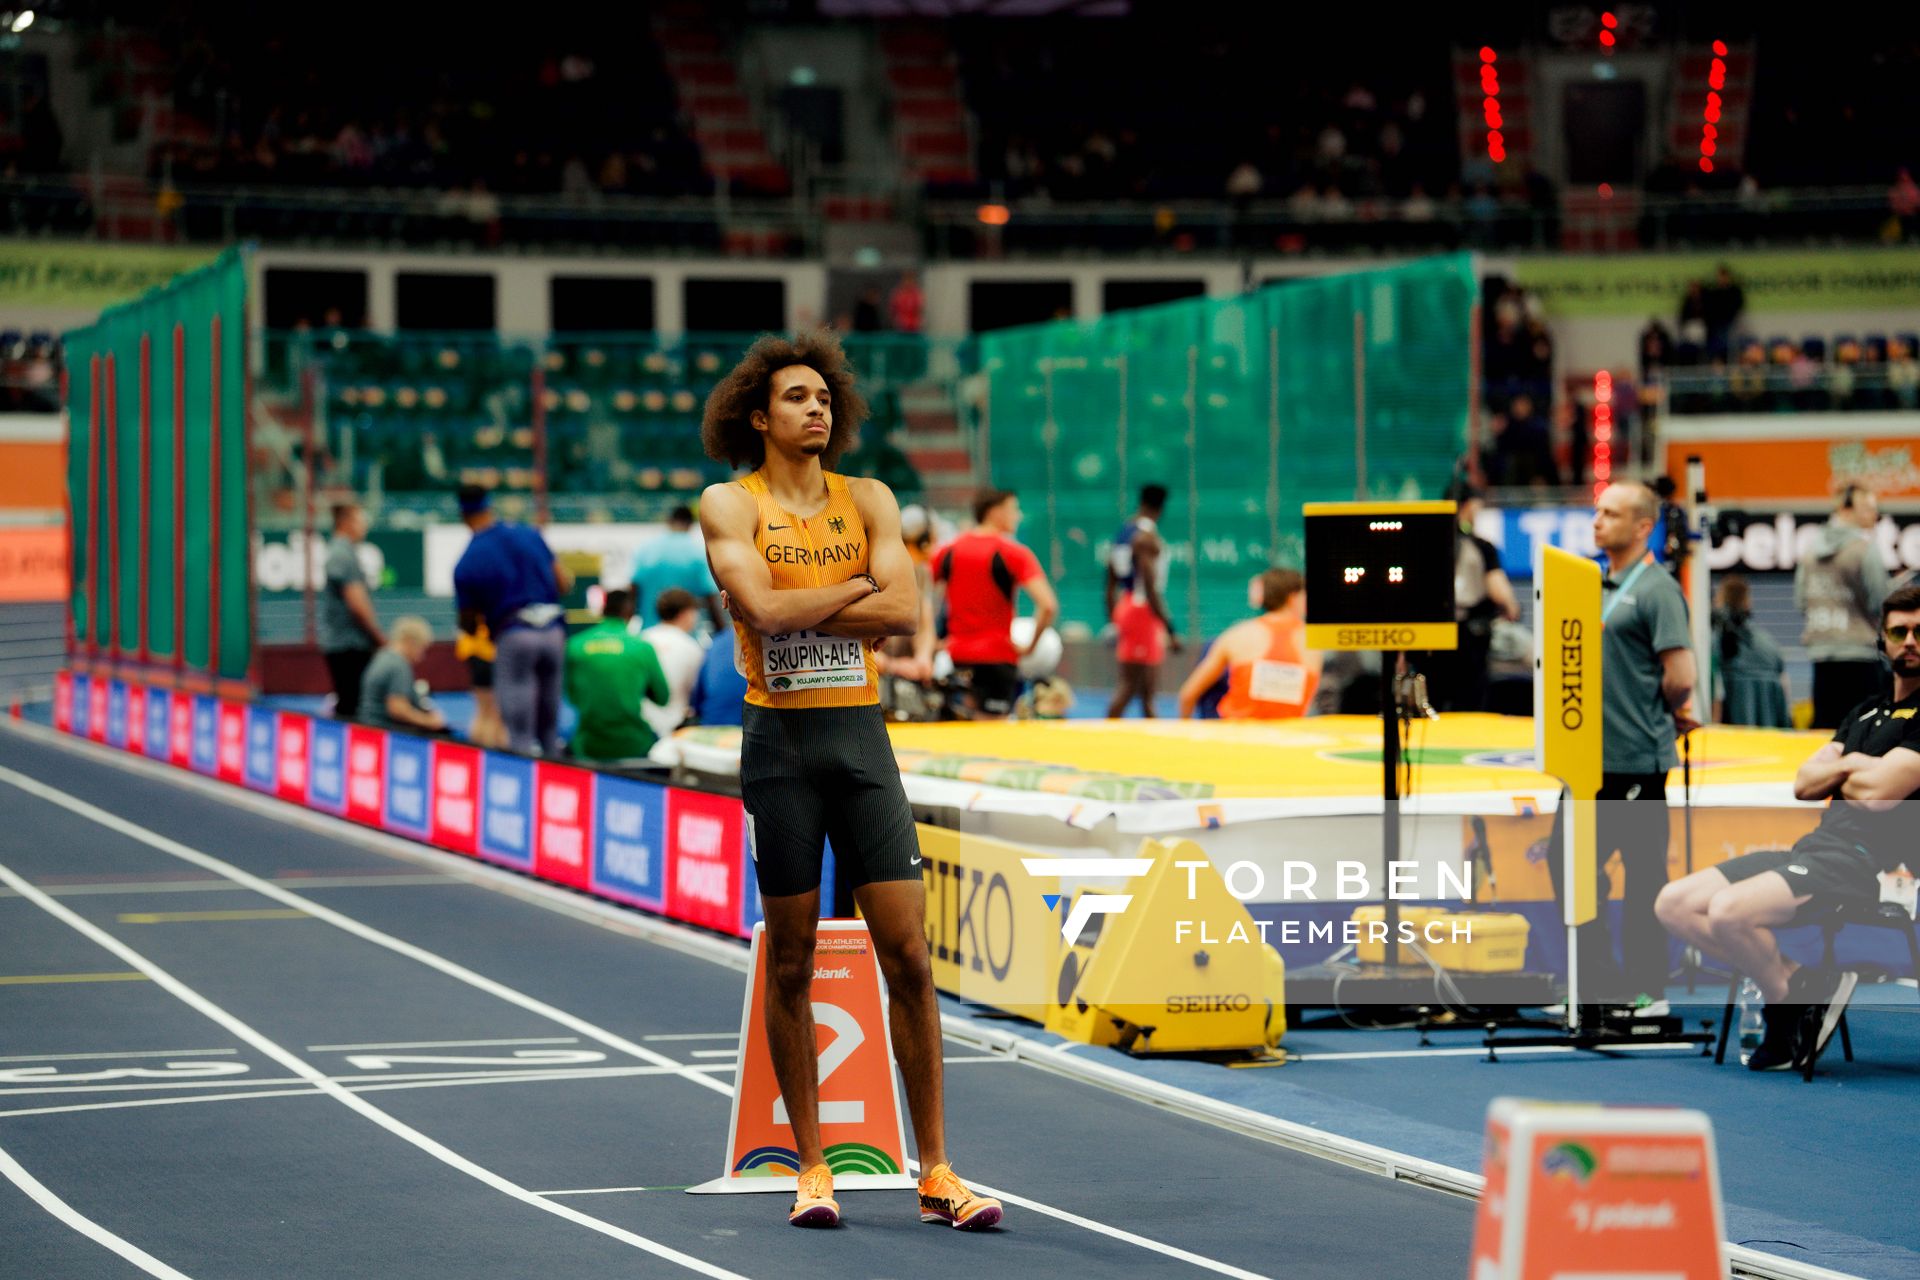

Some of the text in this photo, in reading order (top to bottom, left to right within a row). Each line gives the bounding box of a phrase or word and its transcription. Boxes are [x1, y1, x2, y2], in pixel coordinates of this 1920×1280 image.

[766, 543, 861, 567] GERMANY
[1337, 628, 1416, 646] SEIKO
[768, 642, 861, 672] SKUPIN-ALFA
[796, 675, 825, 685] KUJAWY
[1561, 619, 1583, 731] SEIKO
[1166, 993, 1250, 1013] SEIKO
[773, 1002, 866, 1125] 2
